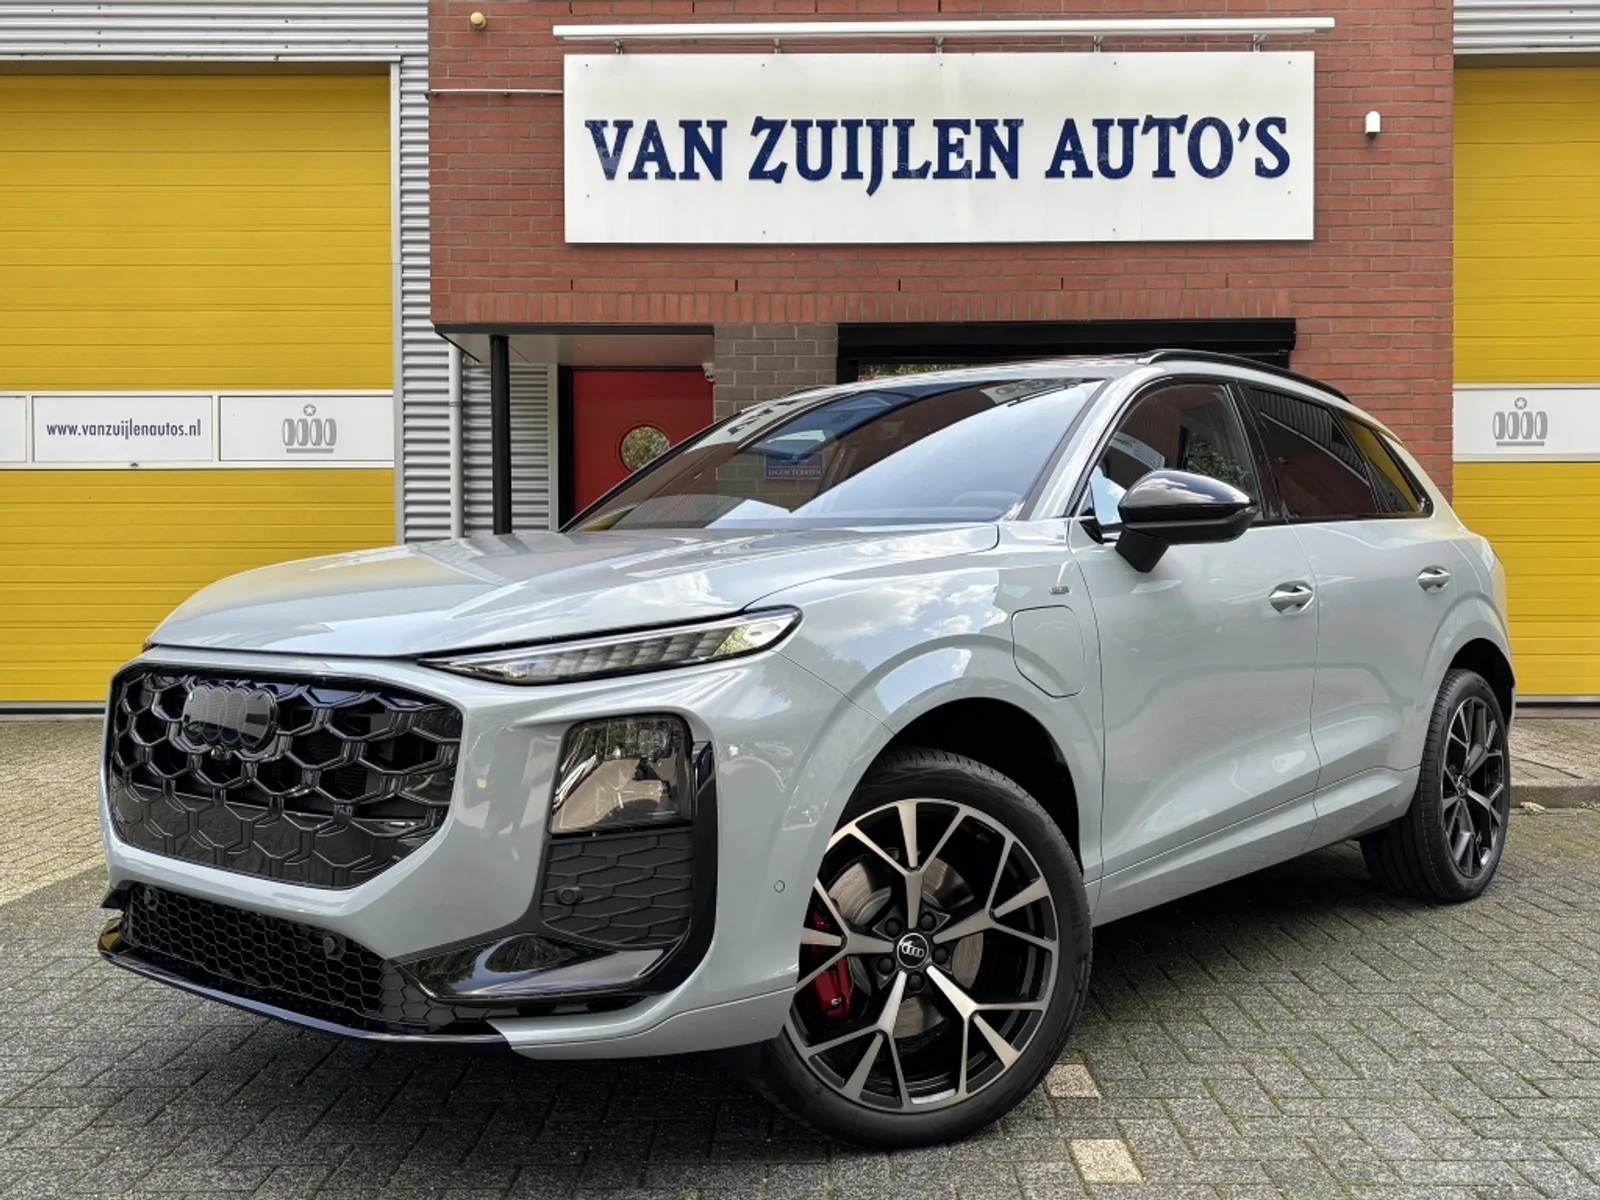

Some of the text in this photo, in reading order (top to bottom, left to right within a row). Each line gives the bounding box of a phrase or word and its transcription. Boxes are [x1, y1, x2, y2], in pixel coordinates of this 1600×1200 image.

[585, 115, 1290, 197] VAN ZUIJLEN AUTO'S
[46, 418, 202, 440] www.vanzuijlenautos.nl
